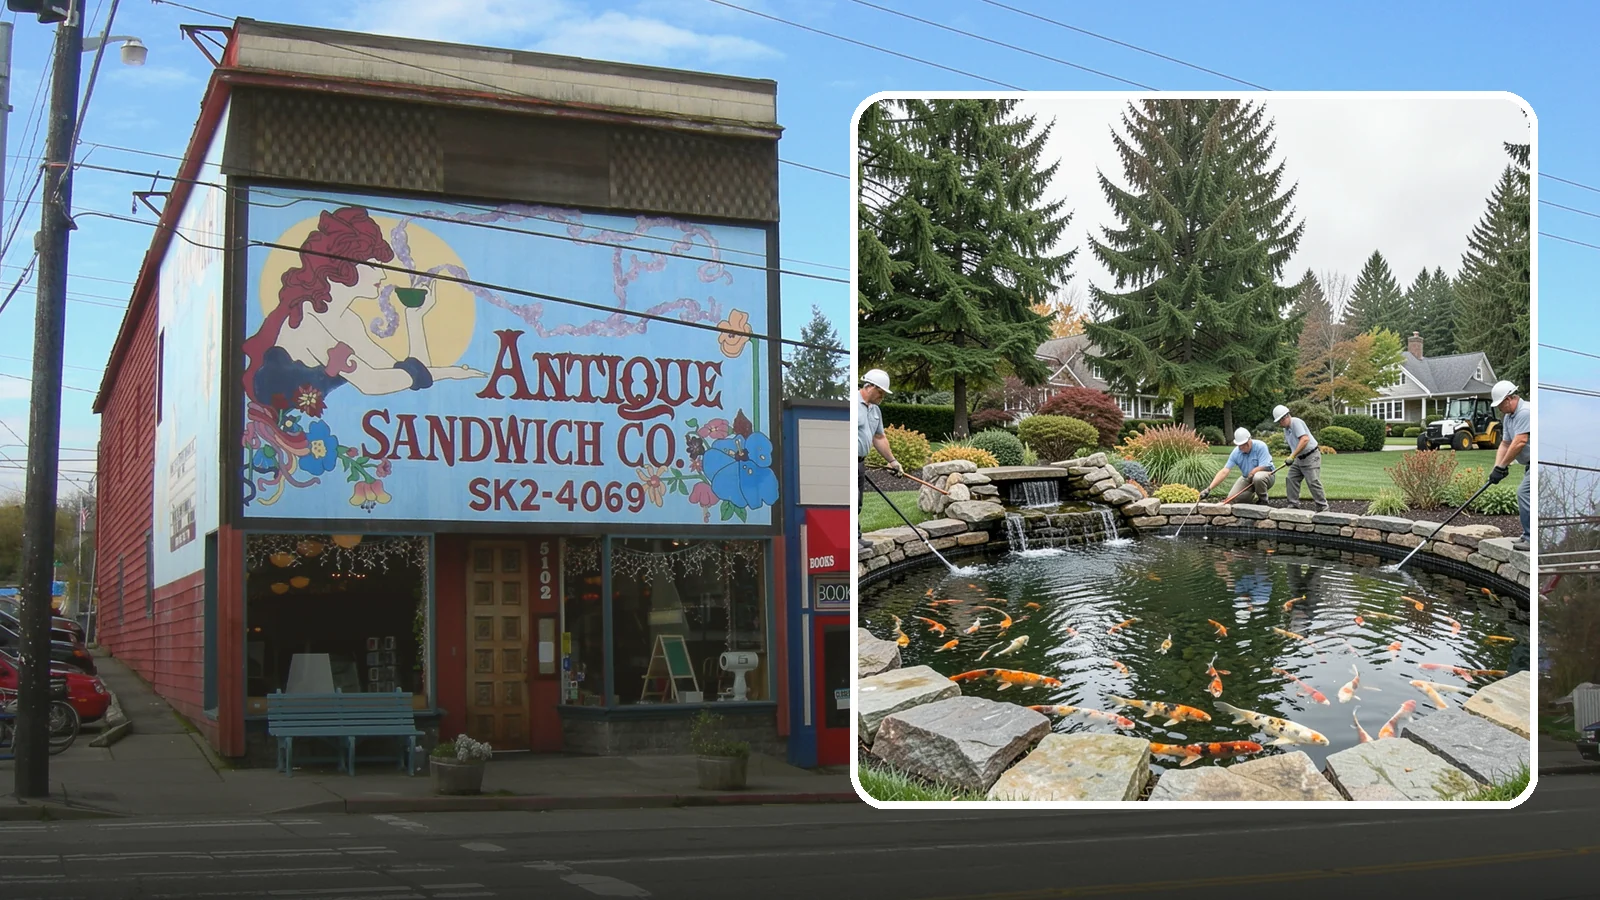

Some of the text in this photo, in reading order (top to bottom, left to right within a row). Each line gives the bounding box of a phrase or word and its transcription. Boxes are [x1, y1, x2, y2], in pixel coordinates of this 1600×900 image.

[476, 329, 724, 421] ANTIQUE
[361, 408, 686, 469] SANDWICH CO.
[468, 477, 646, 513] SK2-4069
[540, 541, 551, 600] 5102
[809, 555, 835, 569] BOOKS
